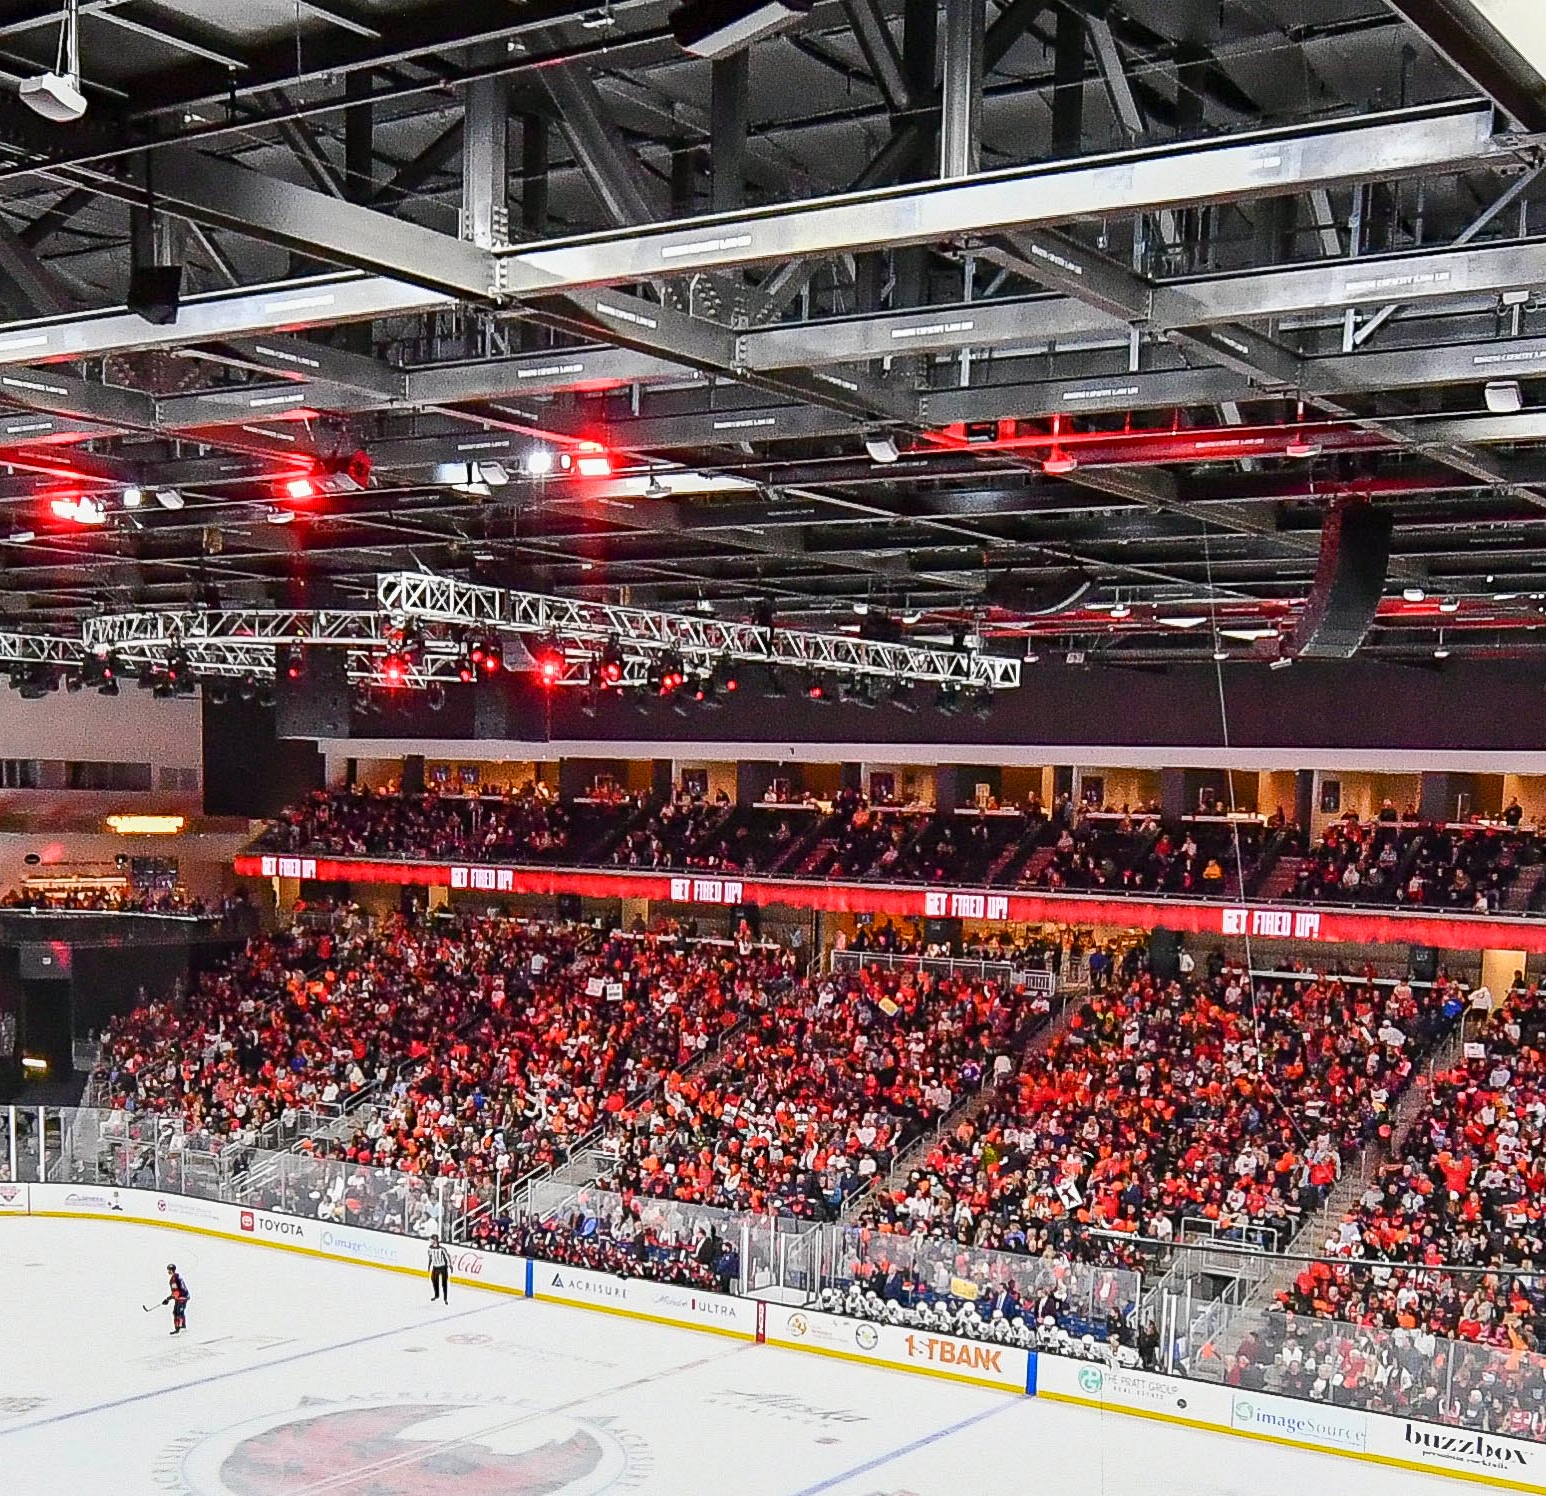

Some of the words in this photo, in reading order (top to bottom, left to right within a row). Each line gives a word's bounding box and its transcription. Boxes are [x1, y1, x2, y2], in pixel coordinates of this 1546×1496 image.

[671, 879, 691, 901] GET
[694, 880, 722, 902] FIRED
[724, 882, 742, 904] UP!
[925, 893, 948, 916] GET
[952, 894, 984, 918] FIRED
[987, 897, 1008, 919] UP!
[1222, 909, 1248, 934] GET
[1253, 910, 1291, 936] FIRED
[1295, 913, 1320, 938] UP!
[258, 1218, 304, 1237] TOYOTA
[568, 1280, 628, 1299] ACRISURE
[699, 1301, 737, 1318] ULTRA
[904, 1334, 1003, 1373] 1STBANK
[1104, 1373, 1120, 1386] THE
[1256, 1411, 1366, 1442] imageSource
[1405, 1423, 1528, 1465] buzzbox
